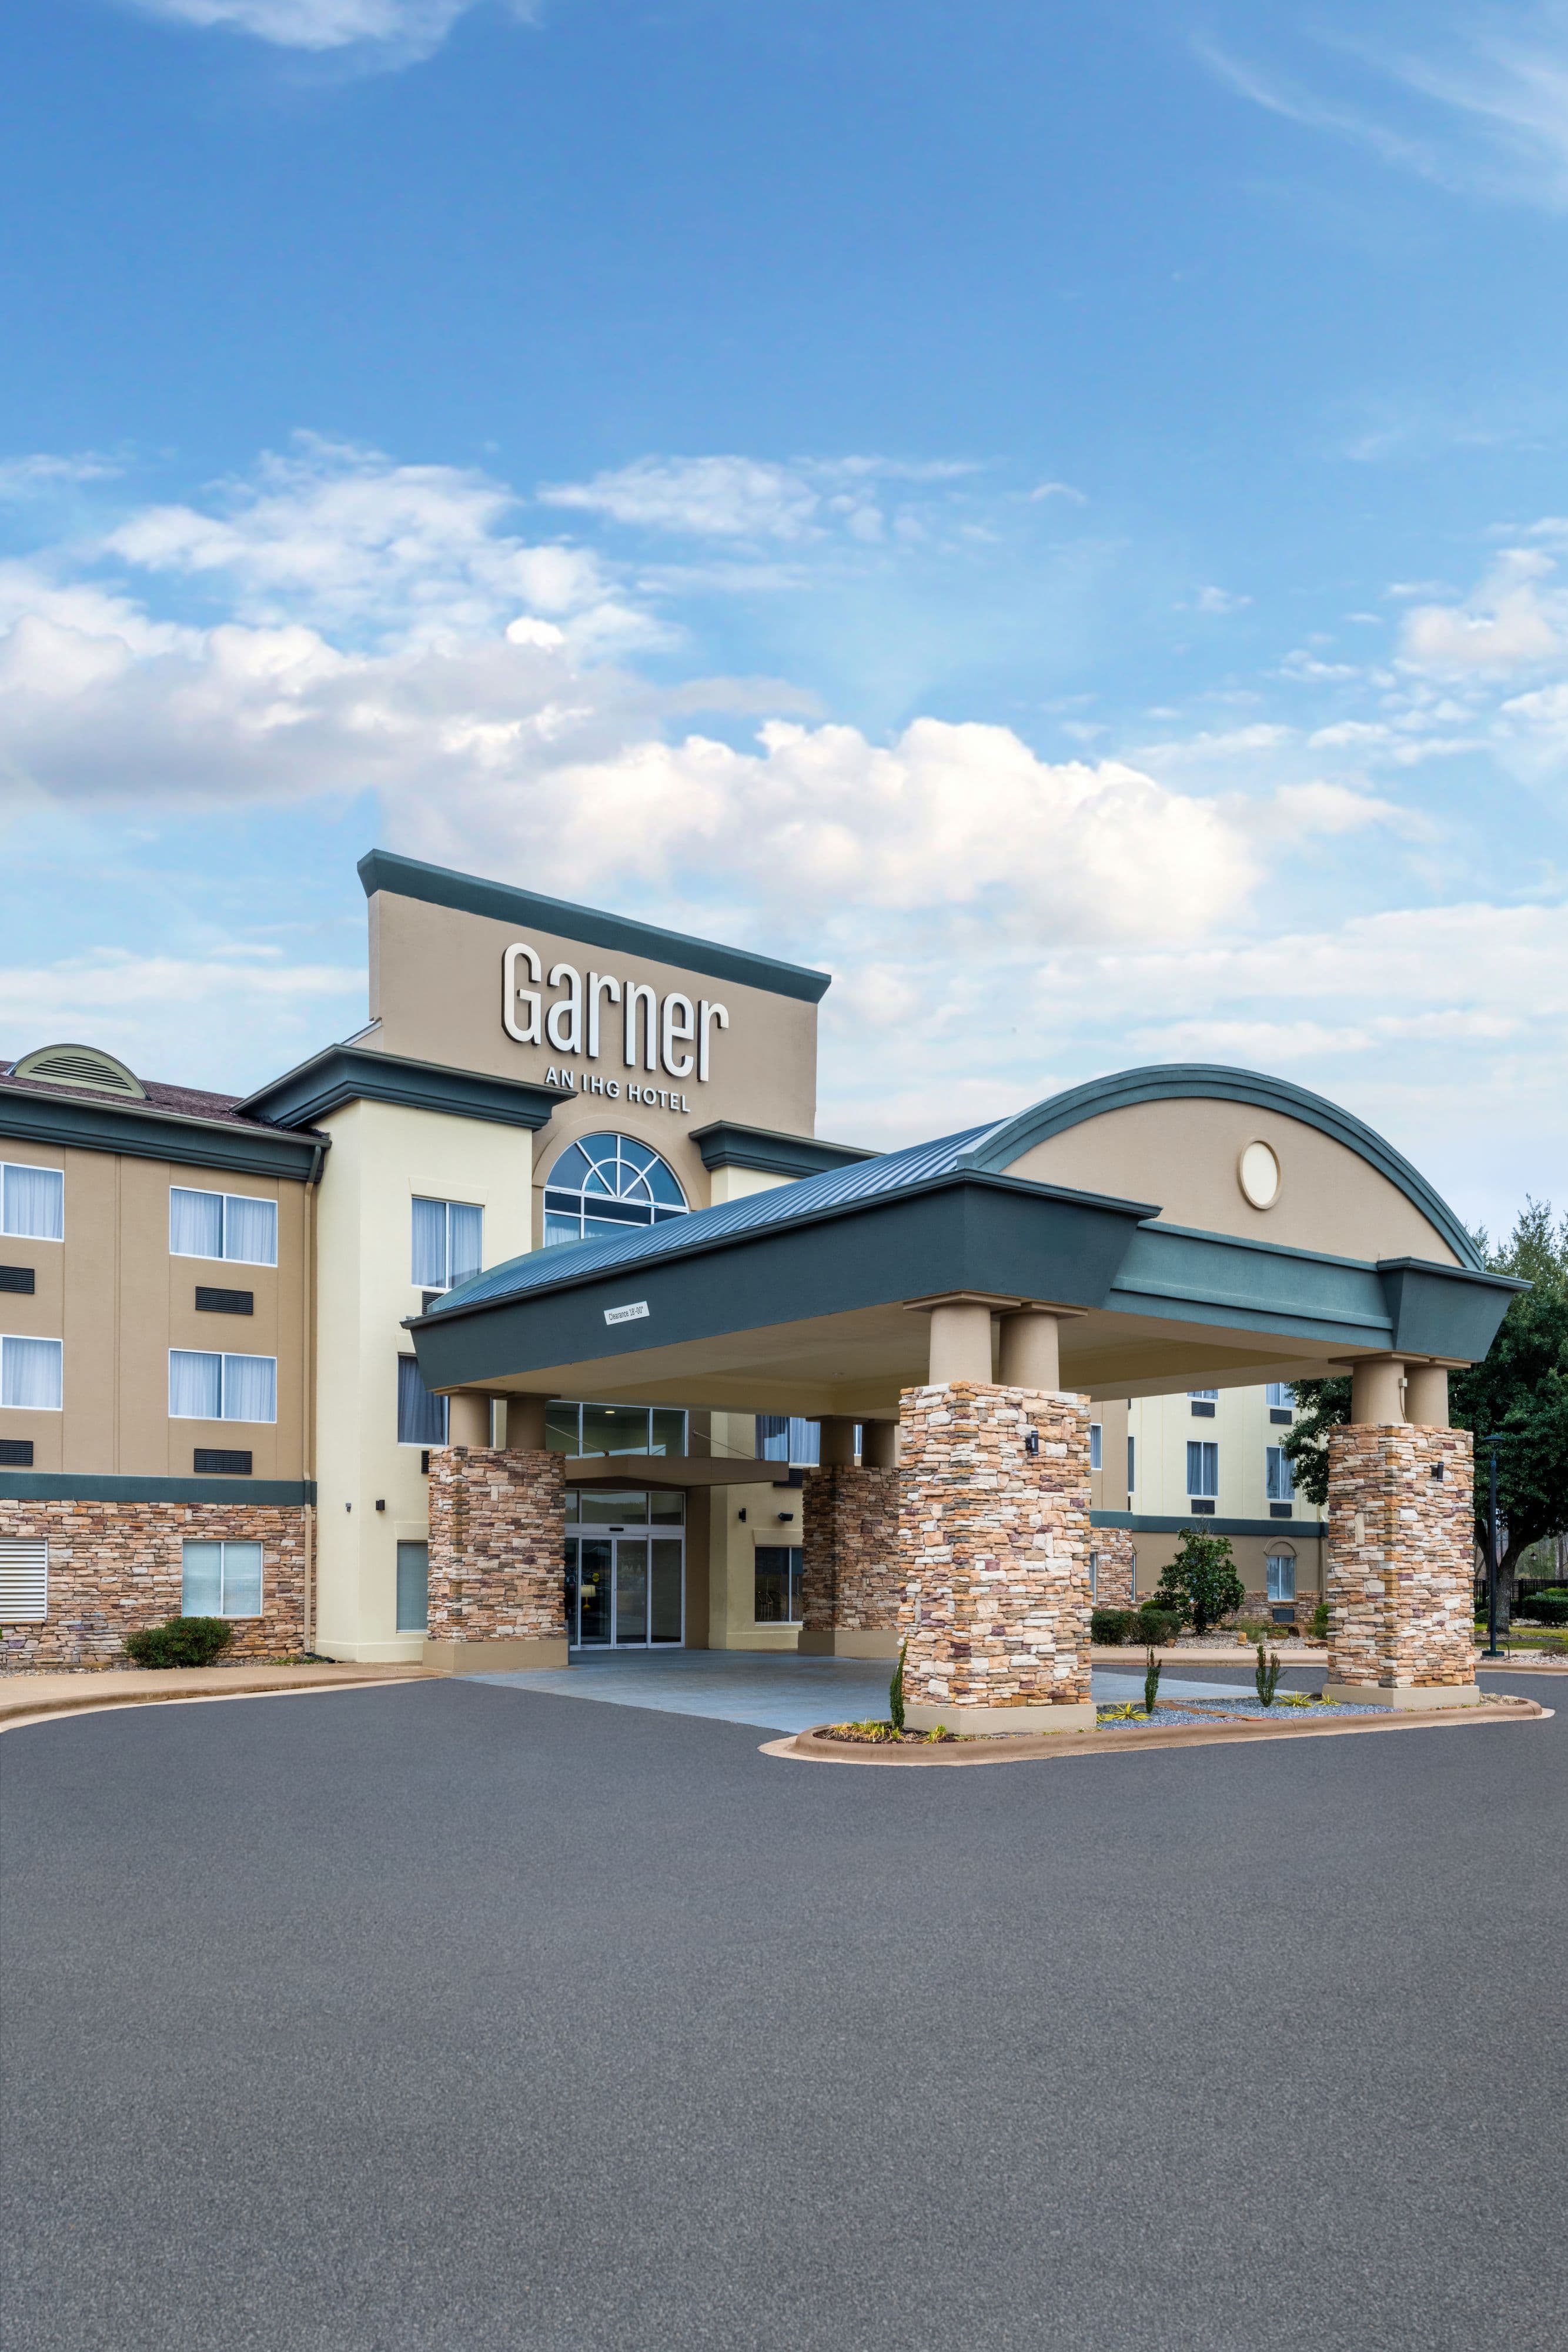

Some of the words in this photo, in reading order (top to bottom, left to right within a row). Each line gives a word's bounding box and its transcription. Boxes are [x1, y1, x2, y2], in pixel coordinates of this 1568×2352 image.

[502, 943, 729, 1082] Garner
[544, 1067, 574, 1088] AN
[581, 1074, 620, 1098] IHG
[627, 1083, 691, 1112] HOTEL
[609, 1311, 629, 1320] Clearance
